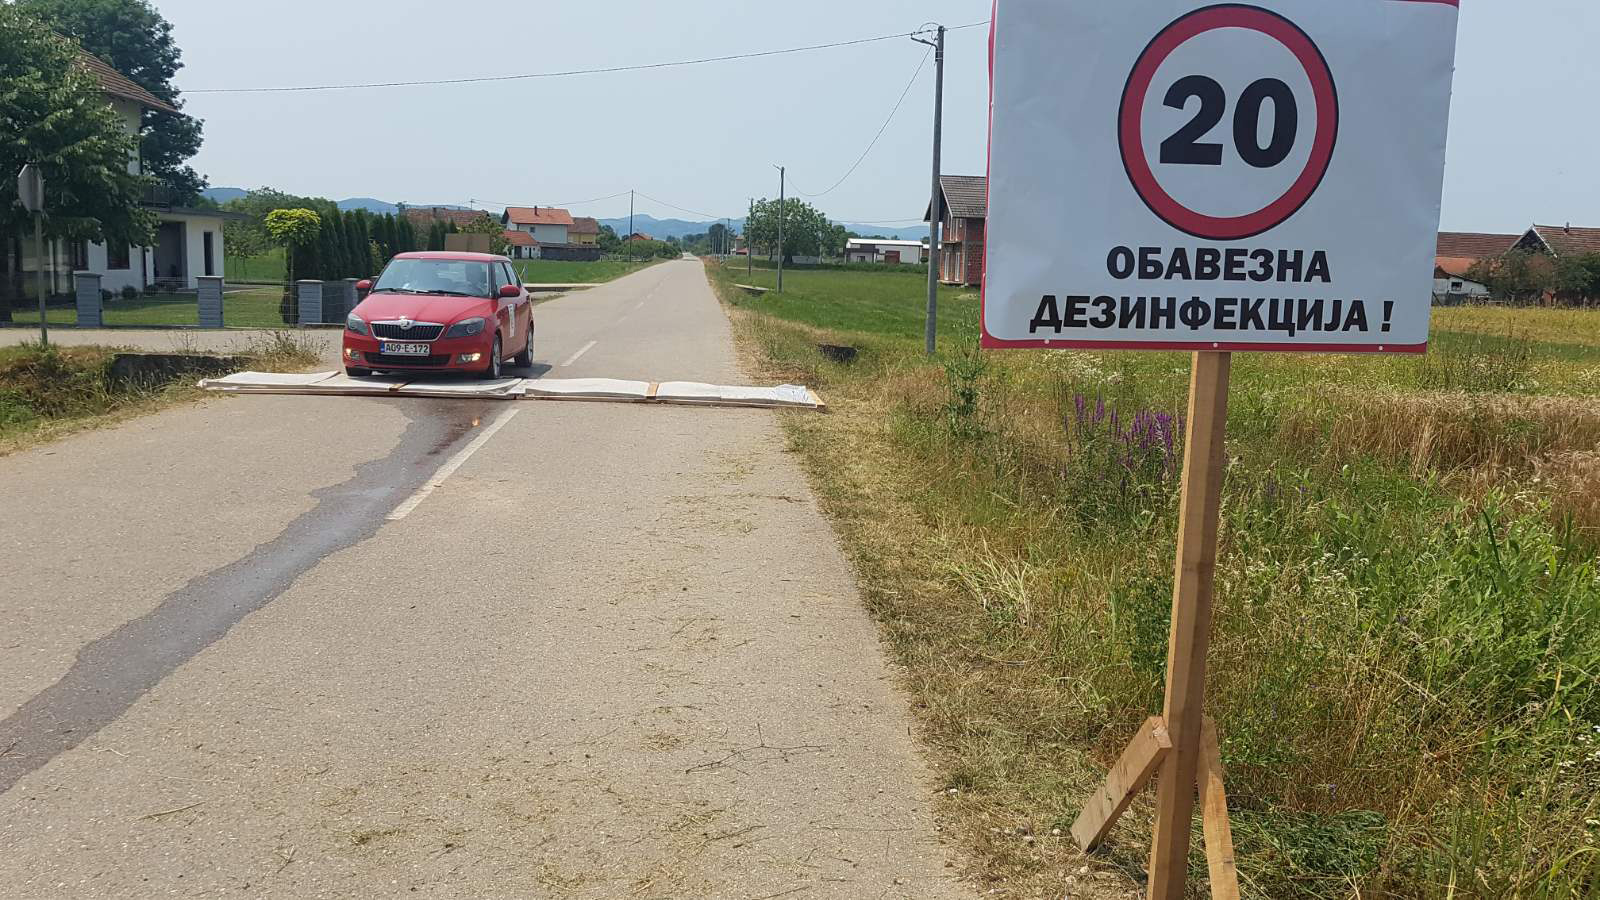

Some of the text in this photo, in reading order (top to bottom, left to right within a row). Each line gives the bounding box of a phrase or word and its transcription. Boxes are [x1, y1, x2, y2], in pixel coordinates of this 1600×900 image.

[1159, 74, 1299, 169] 20
[1106, 245, 1332, 283] ОБАВЕЗНА
[1029, 294, 1369, 338] ДЕЗИНФЕКЦИЈА
[385, 343, 429, 353] A09-E-172
